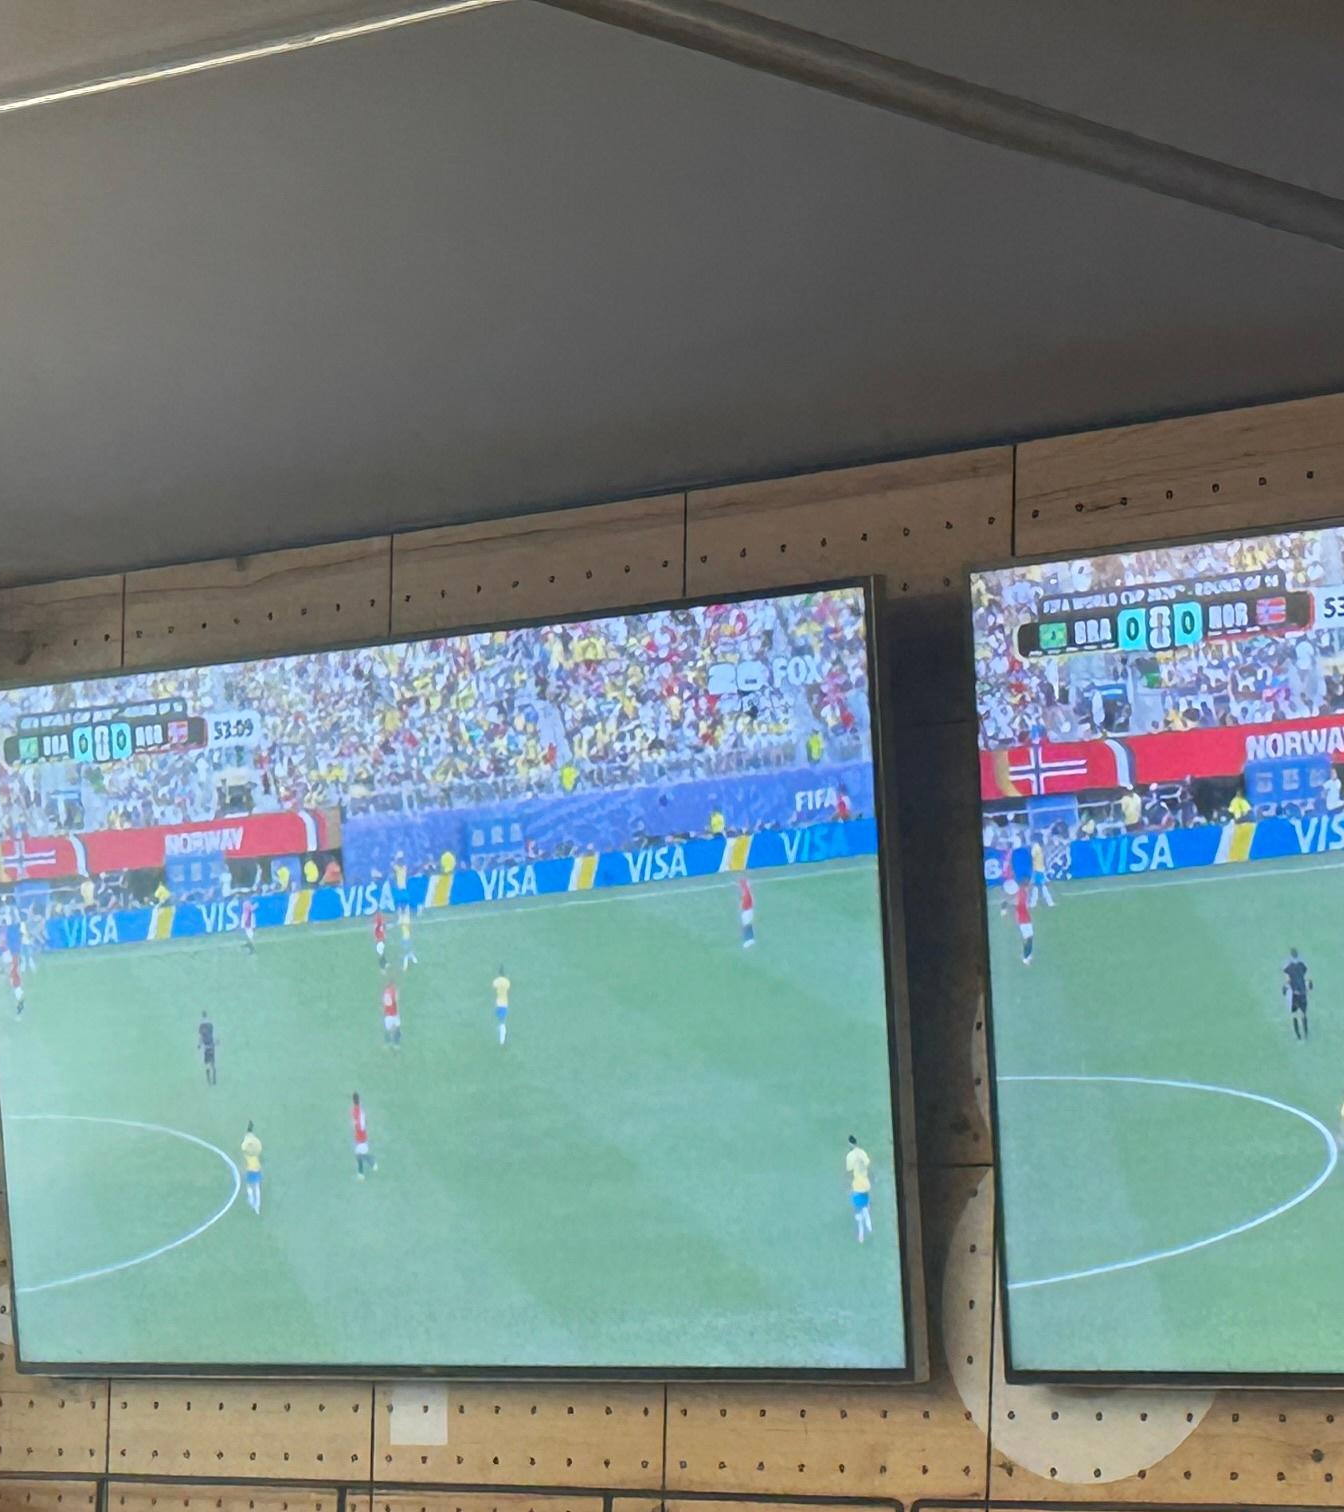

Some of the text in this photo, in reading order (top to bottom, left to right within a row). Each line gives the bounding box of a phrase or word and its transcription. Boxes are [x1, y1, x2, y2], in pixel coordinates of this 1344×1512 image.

[772, 655, 823, 688] FOX
[795, 787, 838, 811] FIFA
[165, 826, 244, 855] NORWAY
[1092, 833, 1174, 874] VISA
[64, 824, 849, 948] VISA VIS VISA VISA VISA VISA
